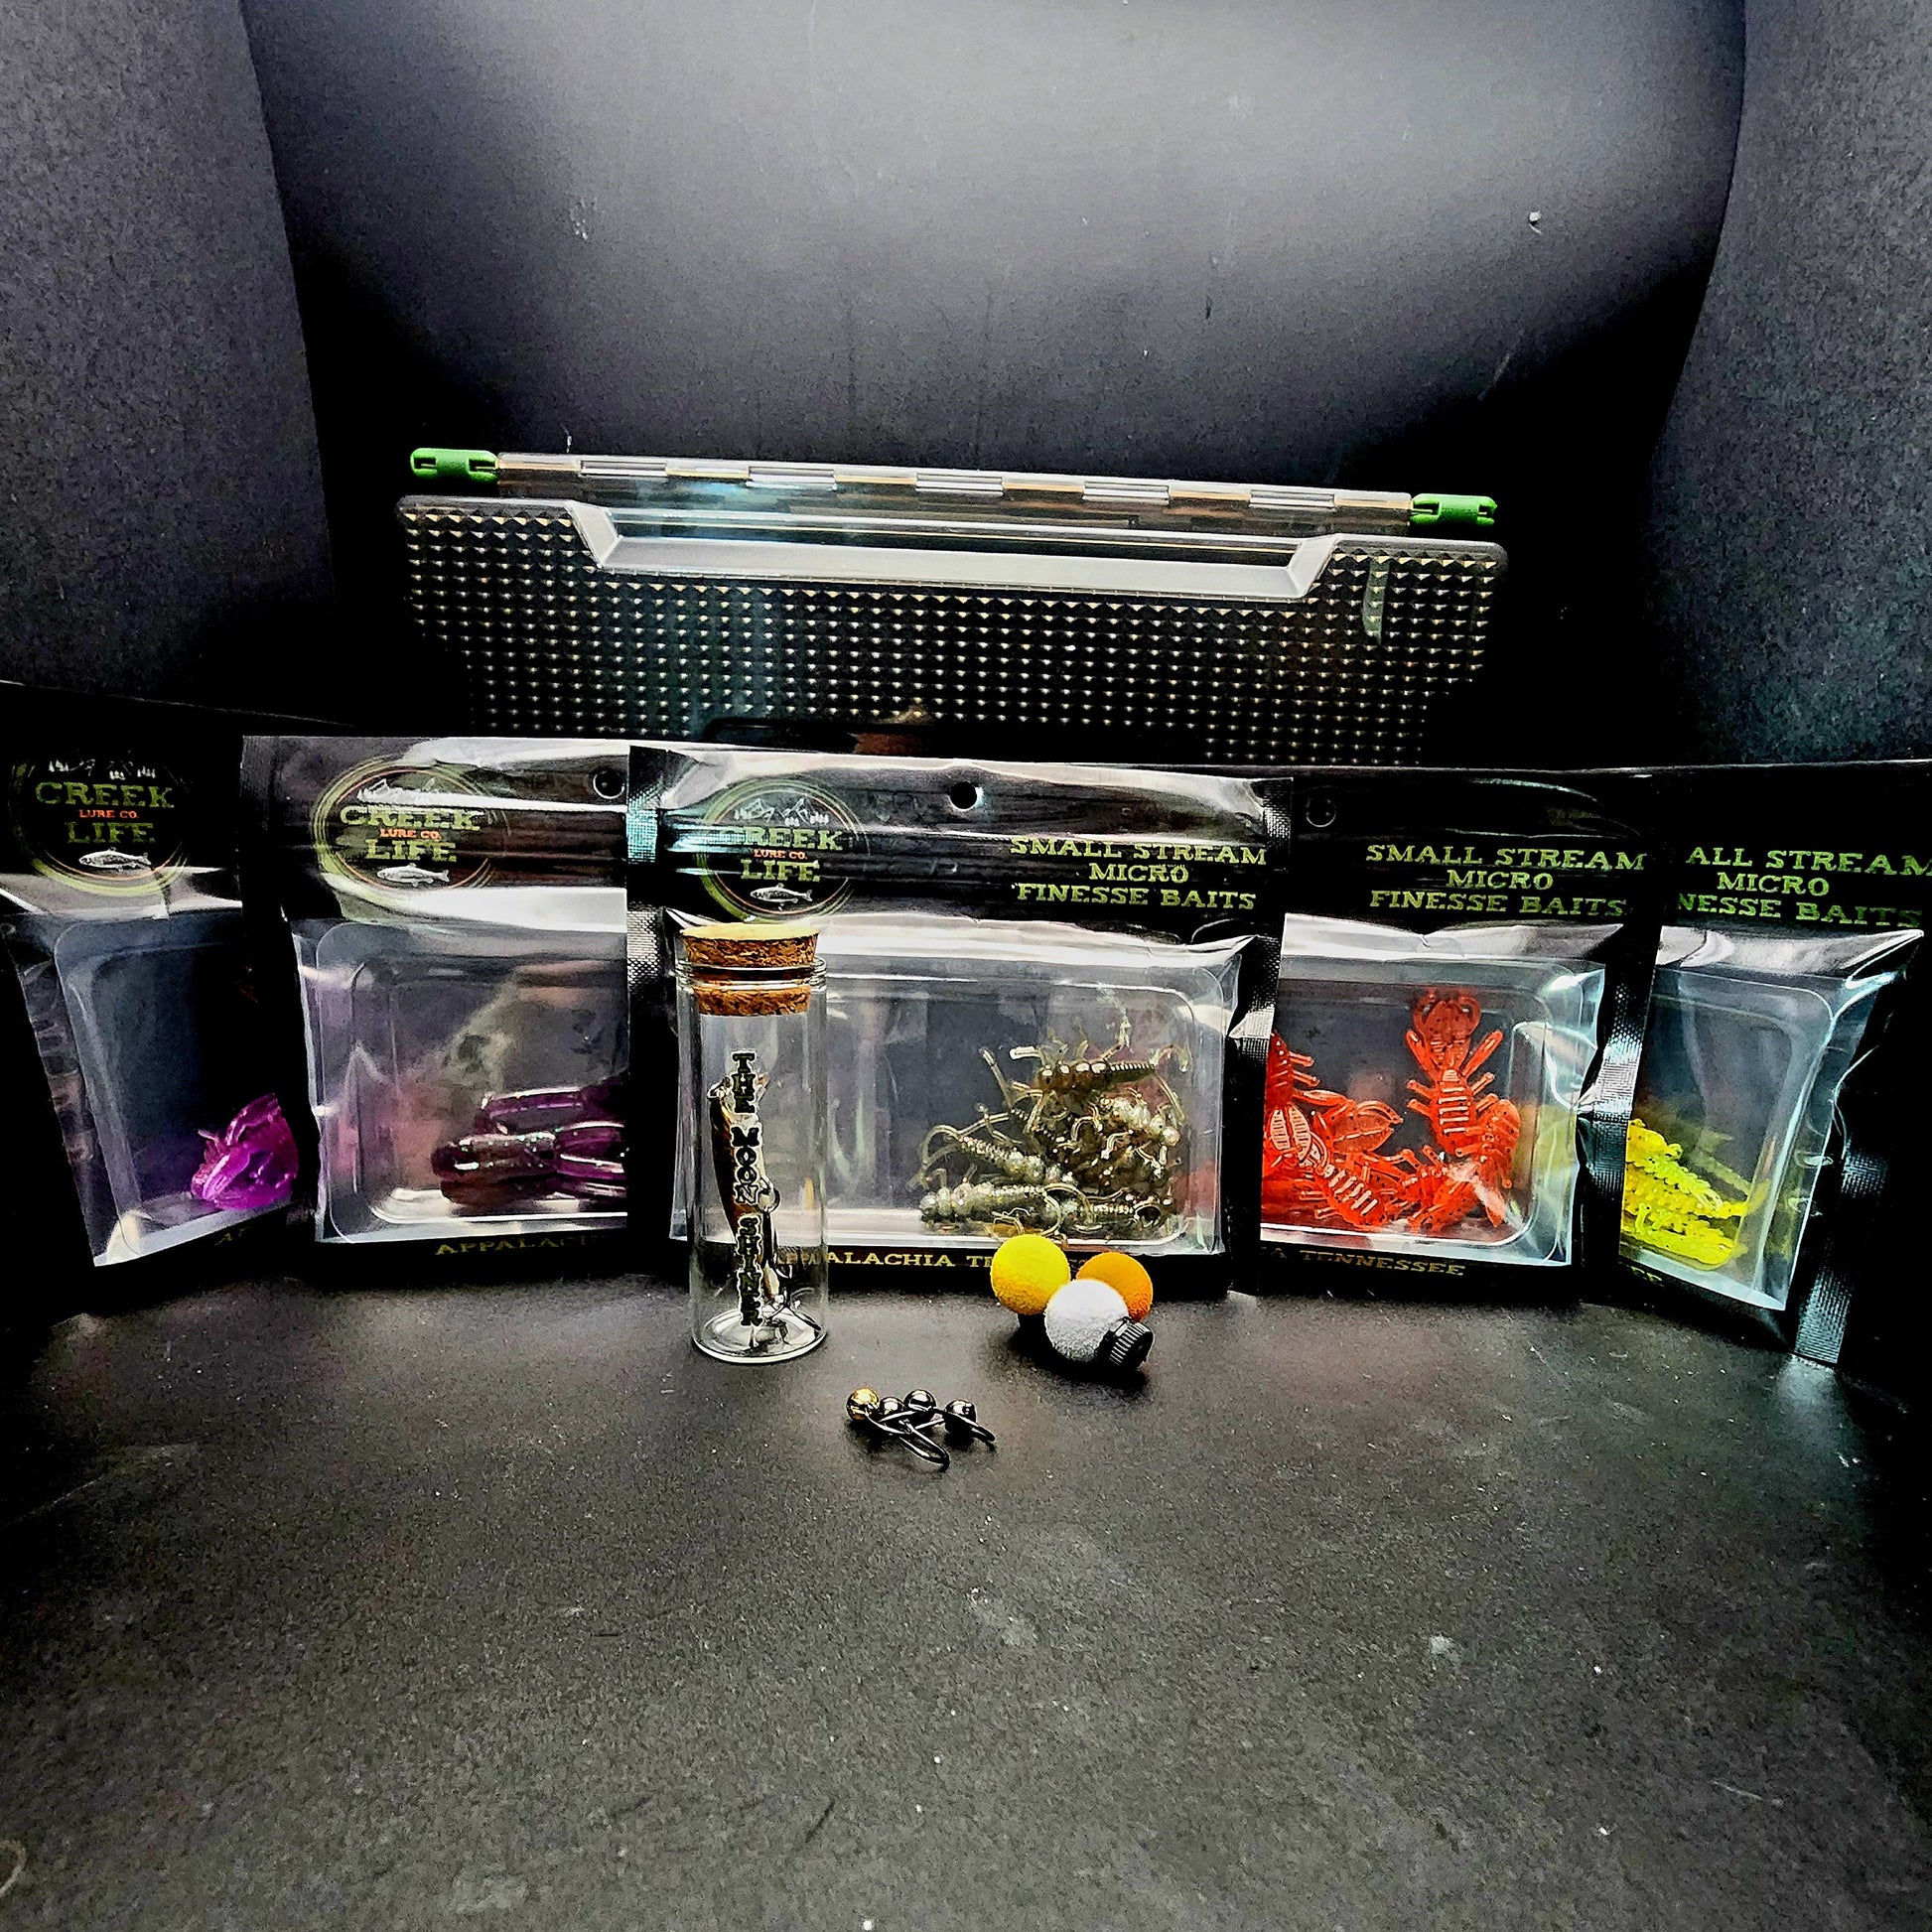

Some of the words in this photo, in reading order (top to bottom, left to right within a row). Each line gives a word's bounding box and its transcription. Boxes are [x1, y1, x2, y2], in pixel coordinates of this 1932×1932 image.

[35, 781, 175, 808] CREEK
[78, 809, 116, 818] LURE
[340, 805, 482, 831] CREEK
[65, 822, 156, 843] LIFE
[379, 828, 416, 839] LURE
[364, 839, 457, 862] LIFE
[753, 849, 786, 859] LURE
[1010, 836, 1122, 859] SMALL
[1133, 844, 1267, 865] STREAM
[1365, 844, 1483, 866] SMALL
[1494, 848, 1648, 871] STREAM
[1685, 846, 1753, 867] ALL
[1765, 850, 1932, 877] STREAM
[741, 859, 820, 883] LIFE
[1089, 862, 1189, 884] MICRO
[1446, 869, 1554, 891] MICRO
[1017, 883, 1149, 905] FINESSE
[1161, 889, 1257, 910] BAITS
[1717, 872, 1830, 897] MICRO
[1369, 890, 1508, 912] FINESSE
[1519, 896, 1627, 916] BAITS
[1678, 893, 1782, 918] NESSE
[1795, 901, 1923, 928] BAITS
[1299, 1249, 1466, 1277] TENNESSEE
